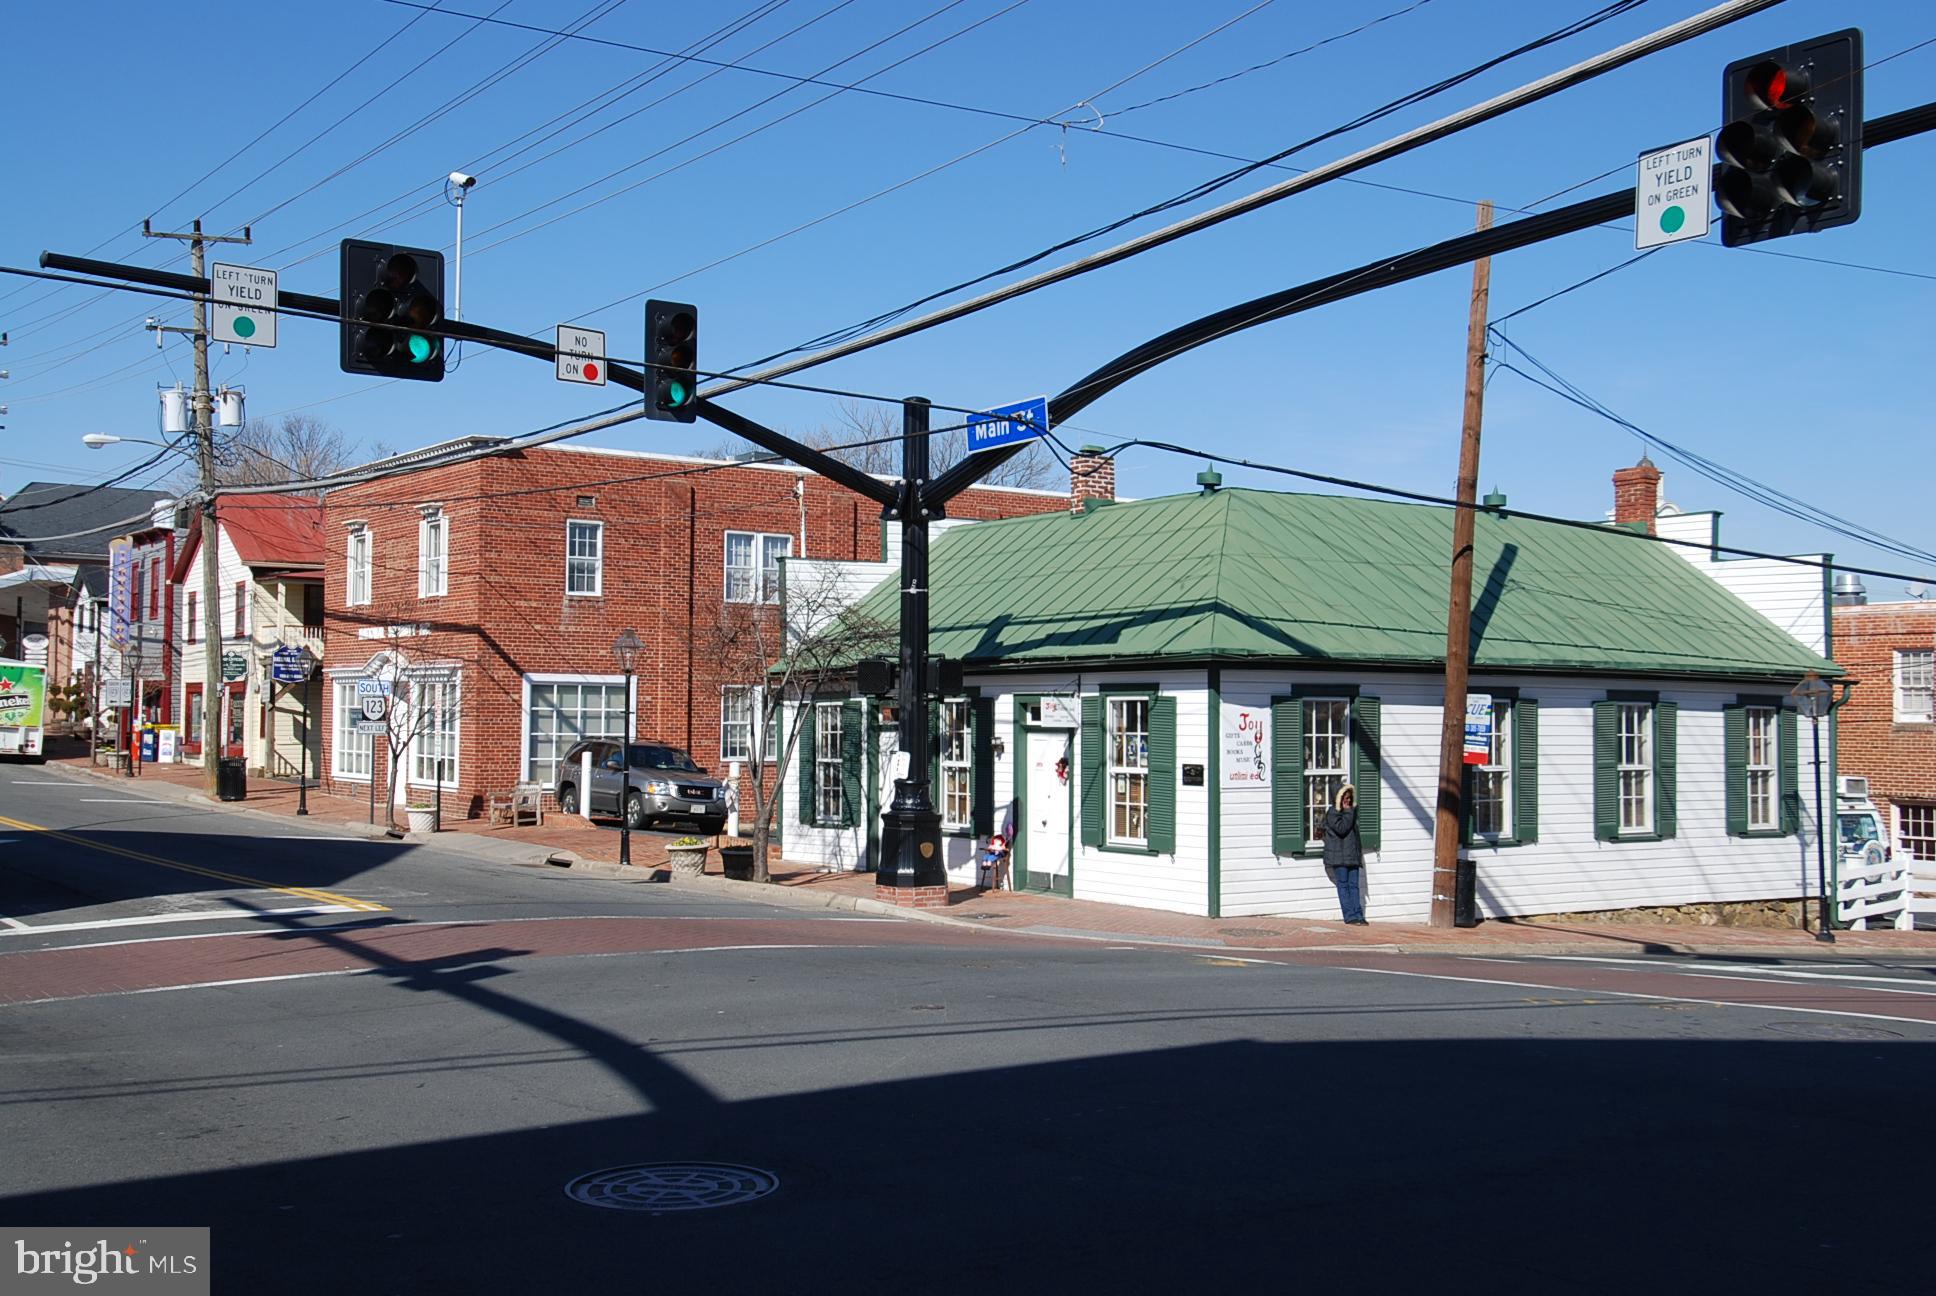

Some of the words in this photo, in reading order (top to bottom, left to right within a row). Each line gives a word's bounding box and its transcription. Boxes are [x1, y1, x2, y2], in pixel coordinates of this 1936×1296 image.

[1646, 153, 1671, 170] LEFT
[1677, 146, 1702, 162] TURN
[1655, 165, 1692, 187] YIELD
[1647, 193, 1661, 206] ON
[1666, 184, 1699, 202] GREEN
[216, 269, 240, 281] LEFT
[248, 273, 274, 286] TURN
[228, 284, 262, 300] YIELD
[575, 336, 588, 348] NO
[565, 362, 579, 374] ON
[974, 420, 1010, 441] Main
[360, 682, 389, 693] SOUTH
[365, 700, 383, 714] 123
